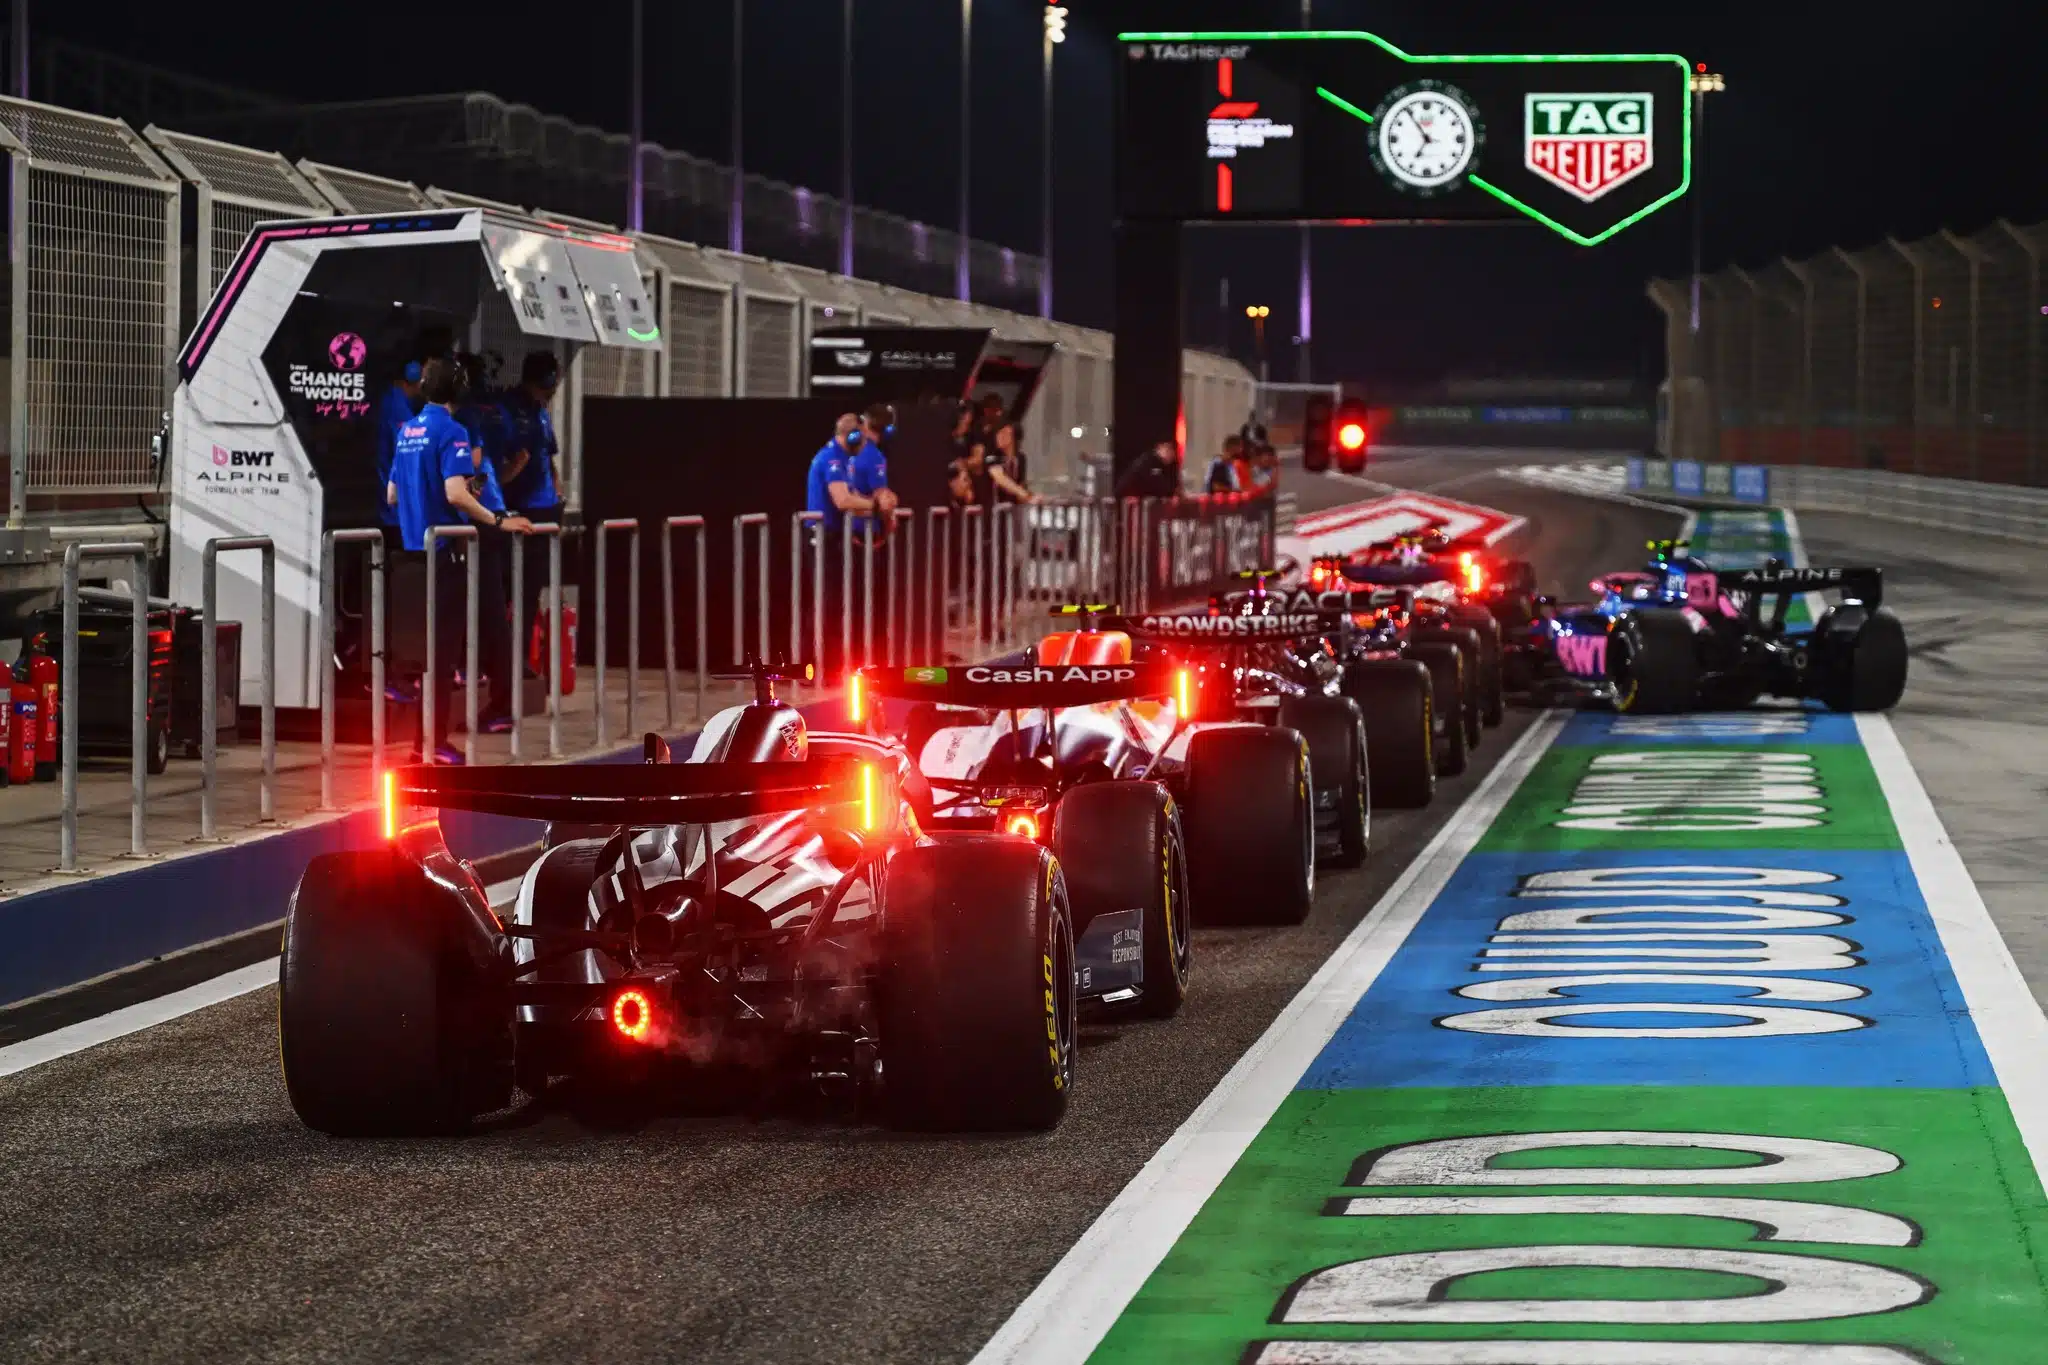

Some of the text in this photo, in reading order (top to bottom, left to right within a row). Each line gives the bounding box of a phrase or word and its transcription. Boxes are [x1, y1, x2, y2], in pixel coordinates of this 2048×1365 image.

[1536, 101, 1641, 134] TAG
[1534, 141, 1645, 191] HEUER
[289, 371, 365, 387] CHANGE
[304, 387, 365, 401] WORLD
[231, 450, 274, 467] BWT
[196, 471, 290, 483] ALPINE
[205, 485, 237, 496] FORMULA
[261, 486, 280, 496] TEAM
[1743, 568, 1842, 582] ALPINE
[1142, 614, 1319, 636] CROWDSTRIKE
[966, 667, 1054, 683] Cash
[1062, 667, 1136, 683] App
[1550, 750, 1829, 831] aramco
[1113, 930, 1123, 946] BEST
[1433, 865, 1874, 1038] aramco
[1043, 954, 1059, 1066] ZERO
